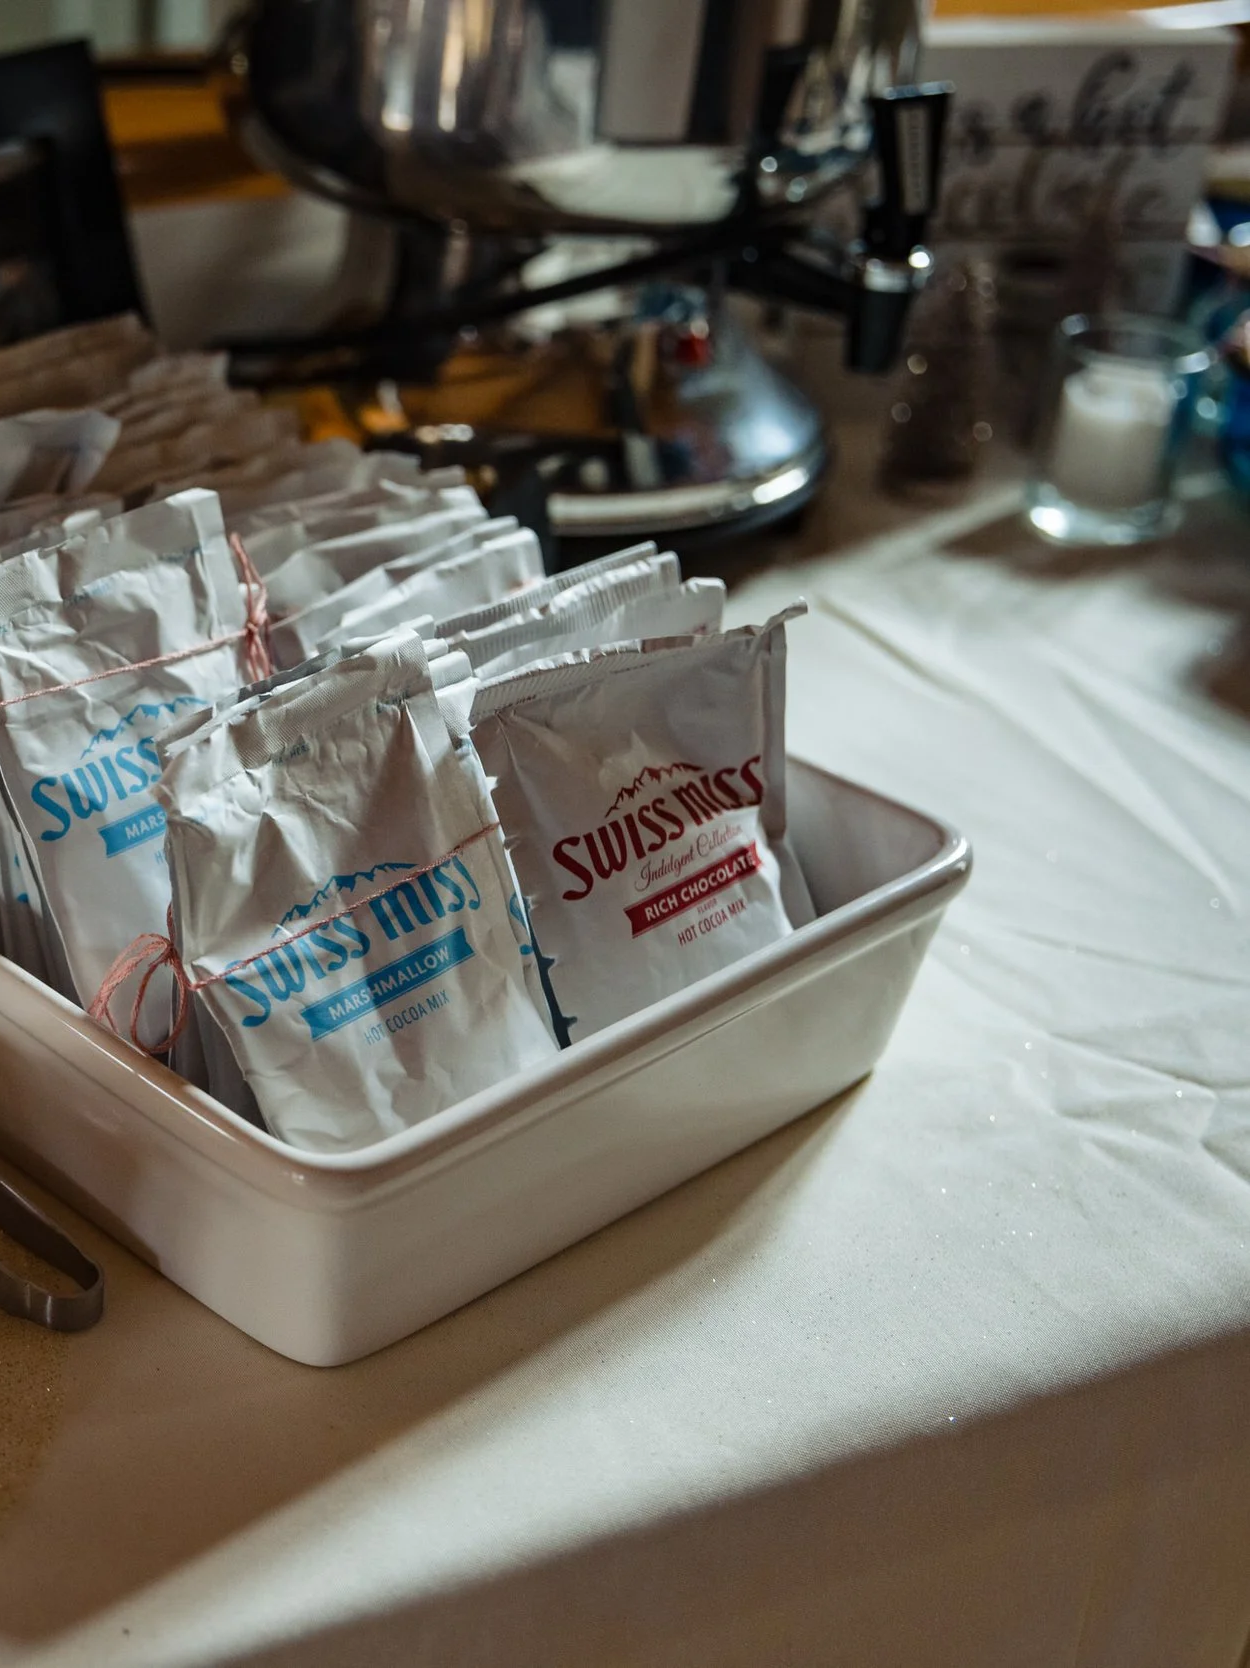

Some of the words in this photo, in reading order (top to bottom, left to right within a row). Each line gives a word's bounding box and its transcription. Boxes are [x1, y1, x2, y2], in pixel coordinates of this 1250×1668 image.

[31, 736, 163, 841] SWISS
[552, 797, 685, 901] SWISS
[671, 755, 764, 827] MISS
[634, 848, 696, 893] Indulgent
[696, 824, 743, 858] Collection
[644, 894, 679, 922] RICH
[680, 853, 756, 902] CHOCOLATE
[677, 924, 698, 946] HOT
[698, 910, 729, 935] COCOA
[728, 898, 747, 917] MIX
[225, 911, 371, 1028] SWISS
[327, 945, 451, 1021] MARSHMALLOW
[363, 1022, 387, 1047] HOT
[386, 1006, 429, 1033] COCOA
[428, 988, 451, 1013] MIX
